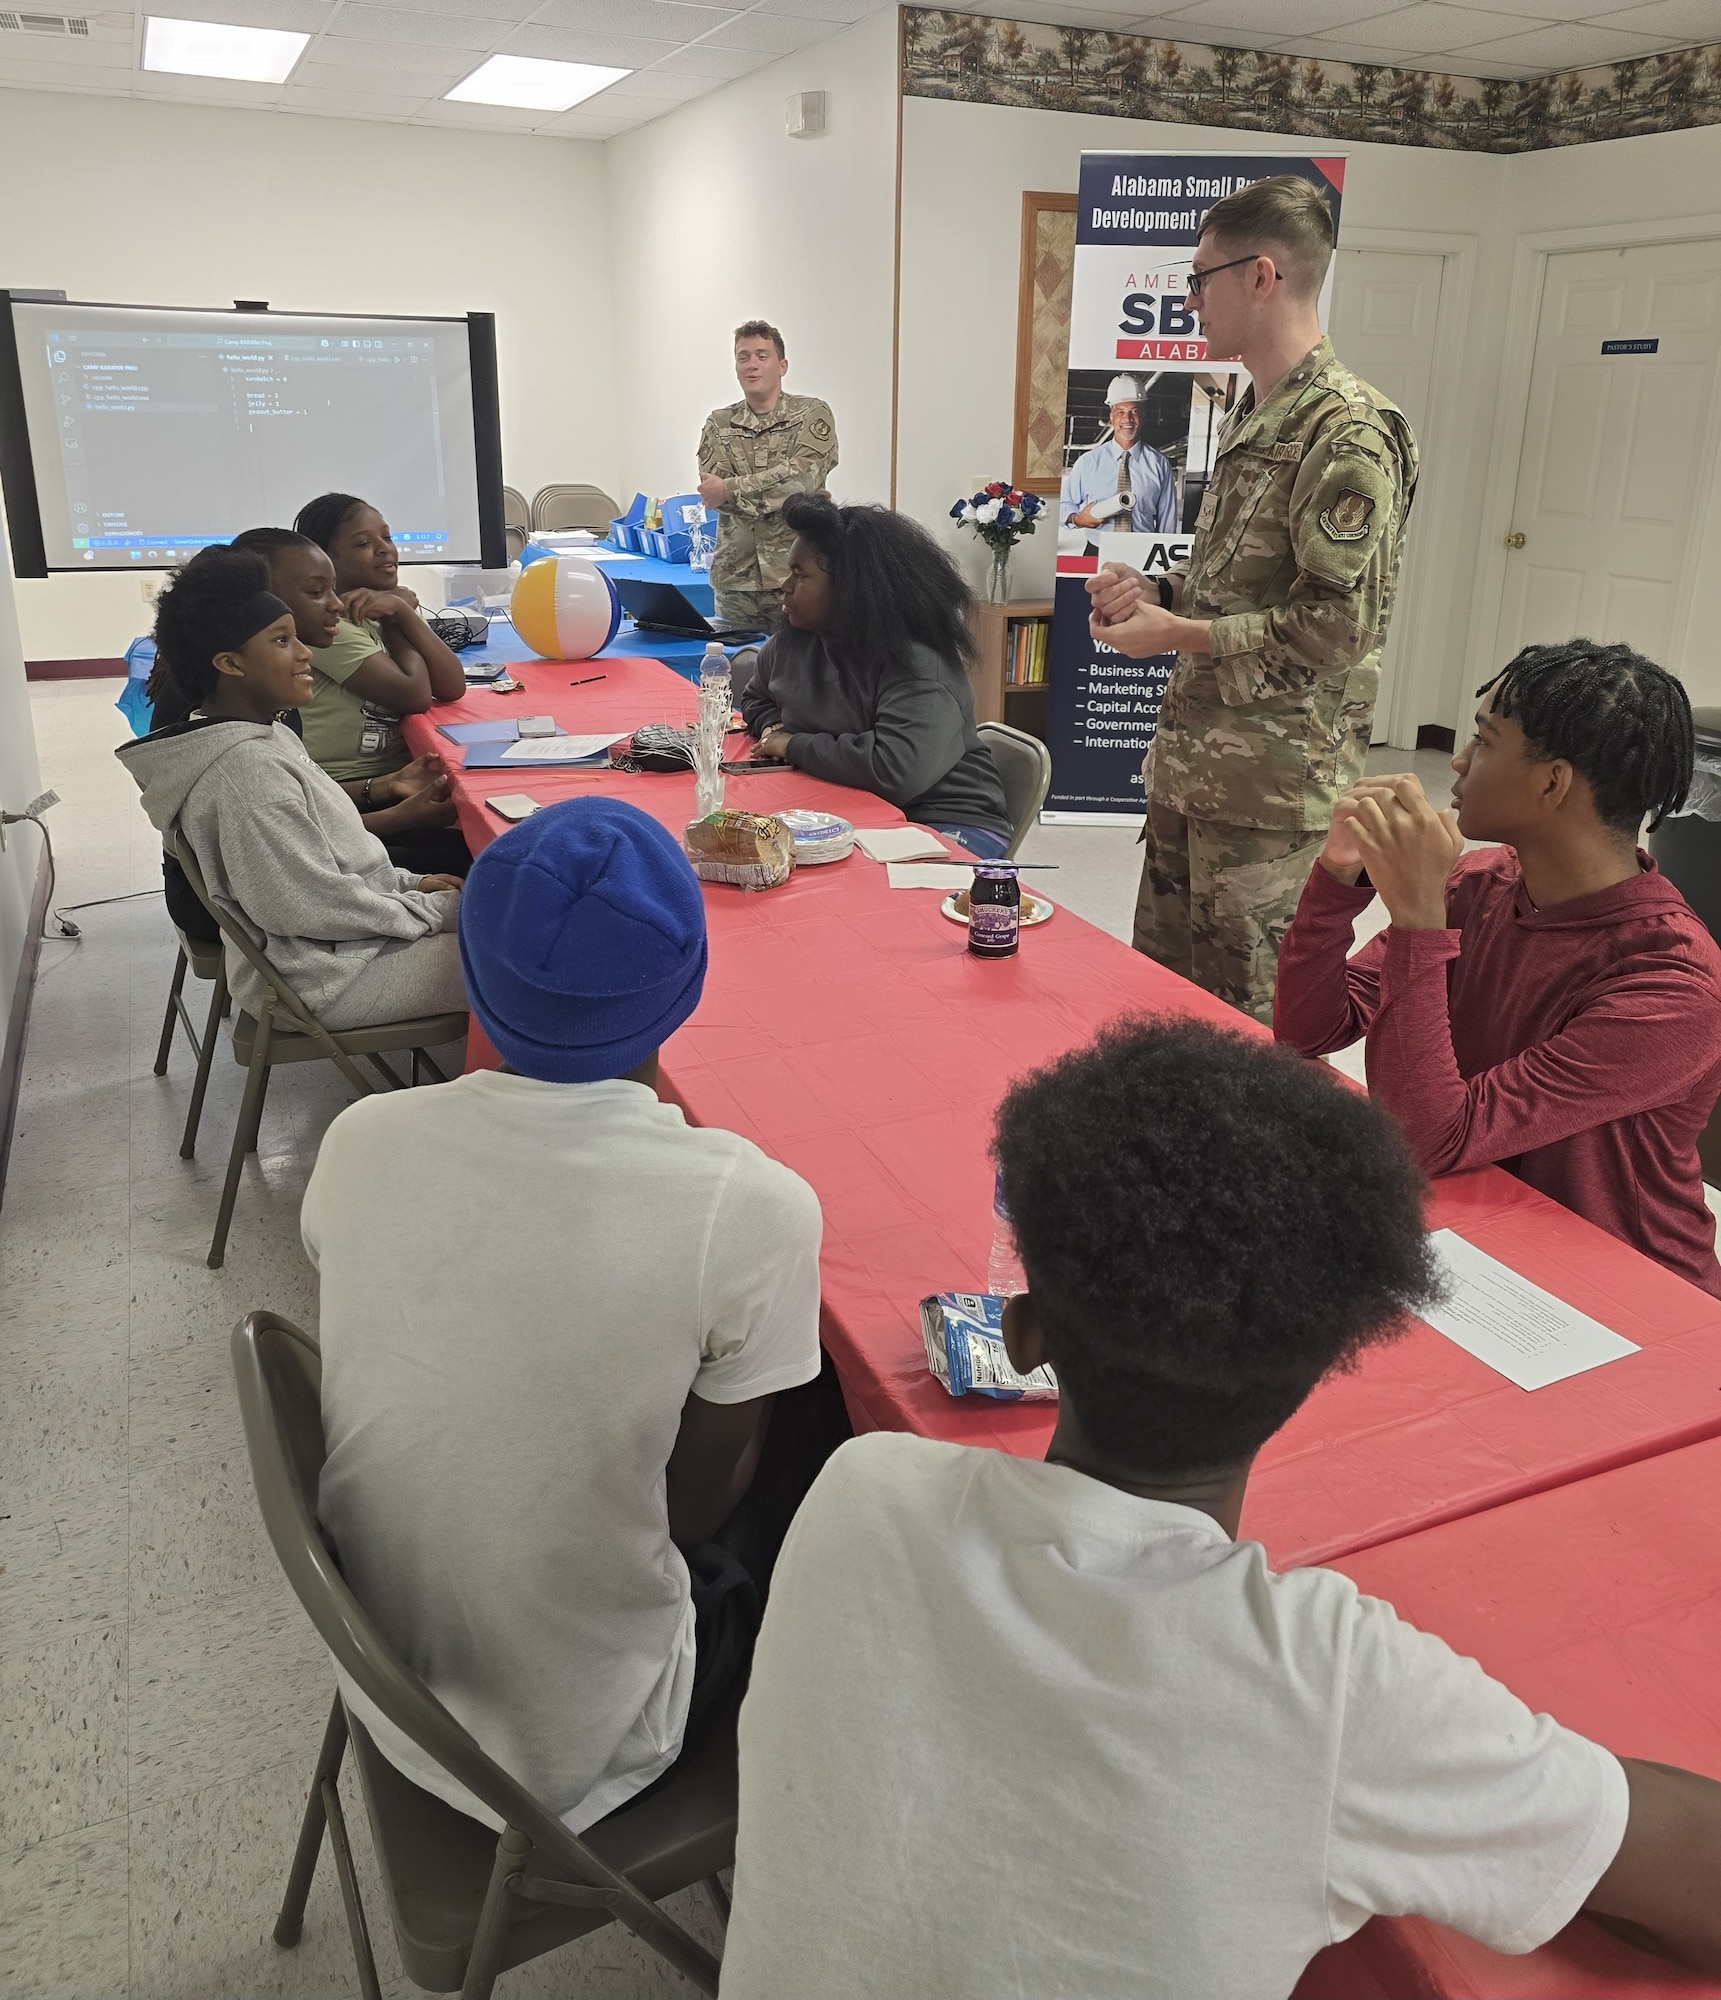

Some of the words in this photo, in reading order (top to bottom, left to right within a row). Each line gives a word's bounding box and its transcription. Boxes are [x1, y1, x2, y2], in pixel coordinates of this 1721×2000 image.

[1111, 175, 1182, 198] Alabama
[1186, 176, 1232, 198] Small
[1092, 208, 1196, 232] Development
[1125, 274, 1190, 288] AME
[1118, 293, 1205, 335] SB
[1139, 343, 1241, 360] ALAB
[248, 400, 266, 408] jelly
[1143, 544, 1194, 571] AS
[1090, 664, 1144, 678] Business
[1147, 666, 1172, 678] Adv
[1089, 682, 1154, 698] Marketing
[1156, 684, 1167, 696] St
[1087, 700, 1131, 714] Capital
[1134, 702, 1162, 714] Acce
[1086, 718, 1158, 732] Governmen
[1085, 736, 1152, 749] Internation
[1130, 775, 1144, 784] as
[974, 931, 994, 939] Concord
